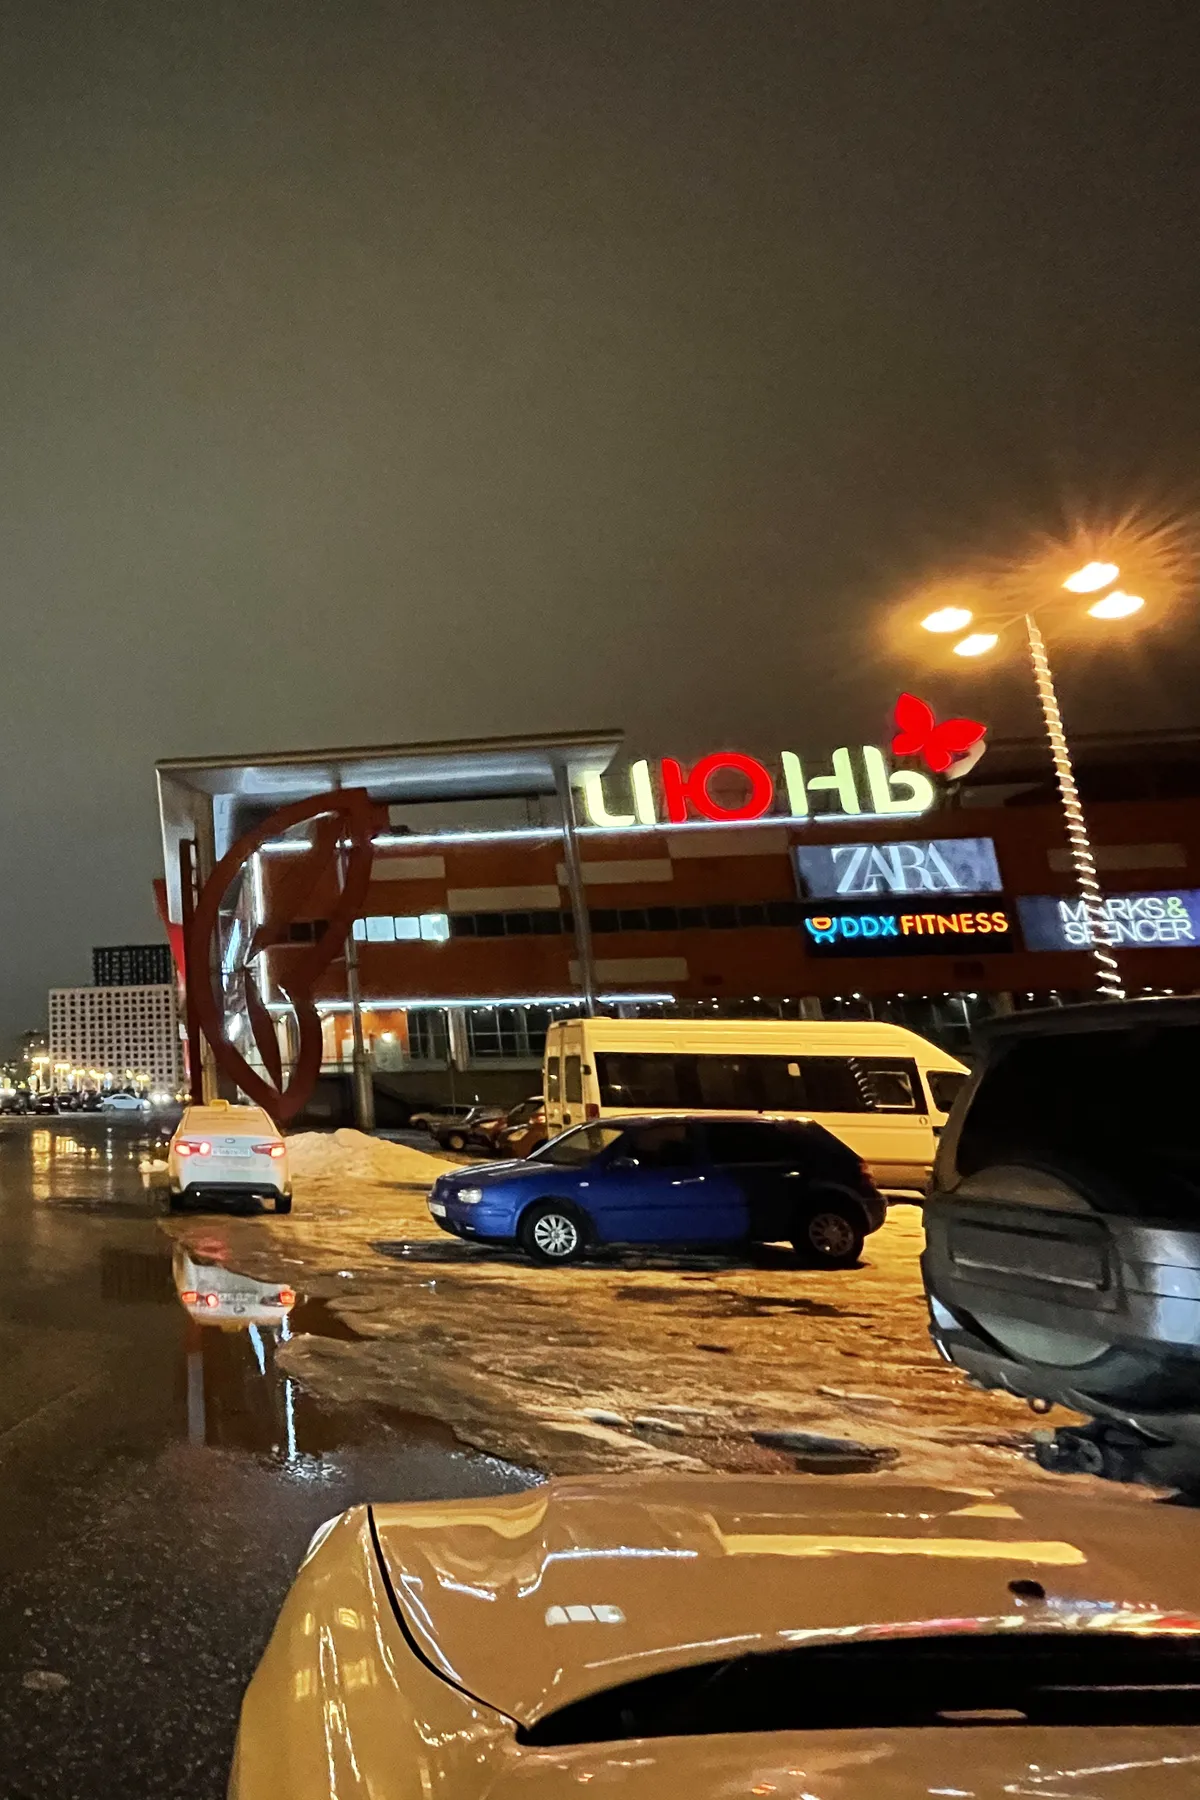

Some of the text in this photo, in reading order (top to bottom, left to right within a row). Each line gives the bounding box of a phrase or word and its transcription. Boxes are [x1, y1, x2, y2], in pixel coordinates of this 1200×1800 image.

[831, 842, 968, 893] ZARA
[840, 912, 1009, 938] DDX FITNESS
